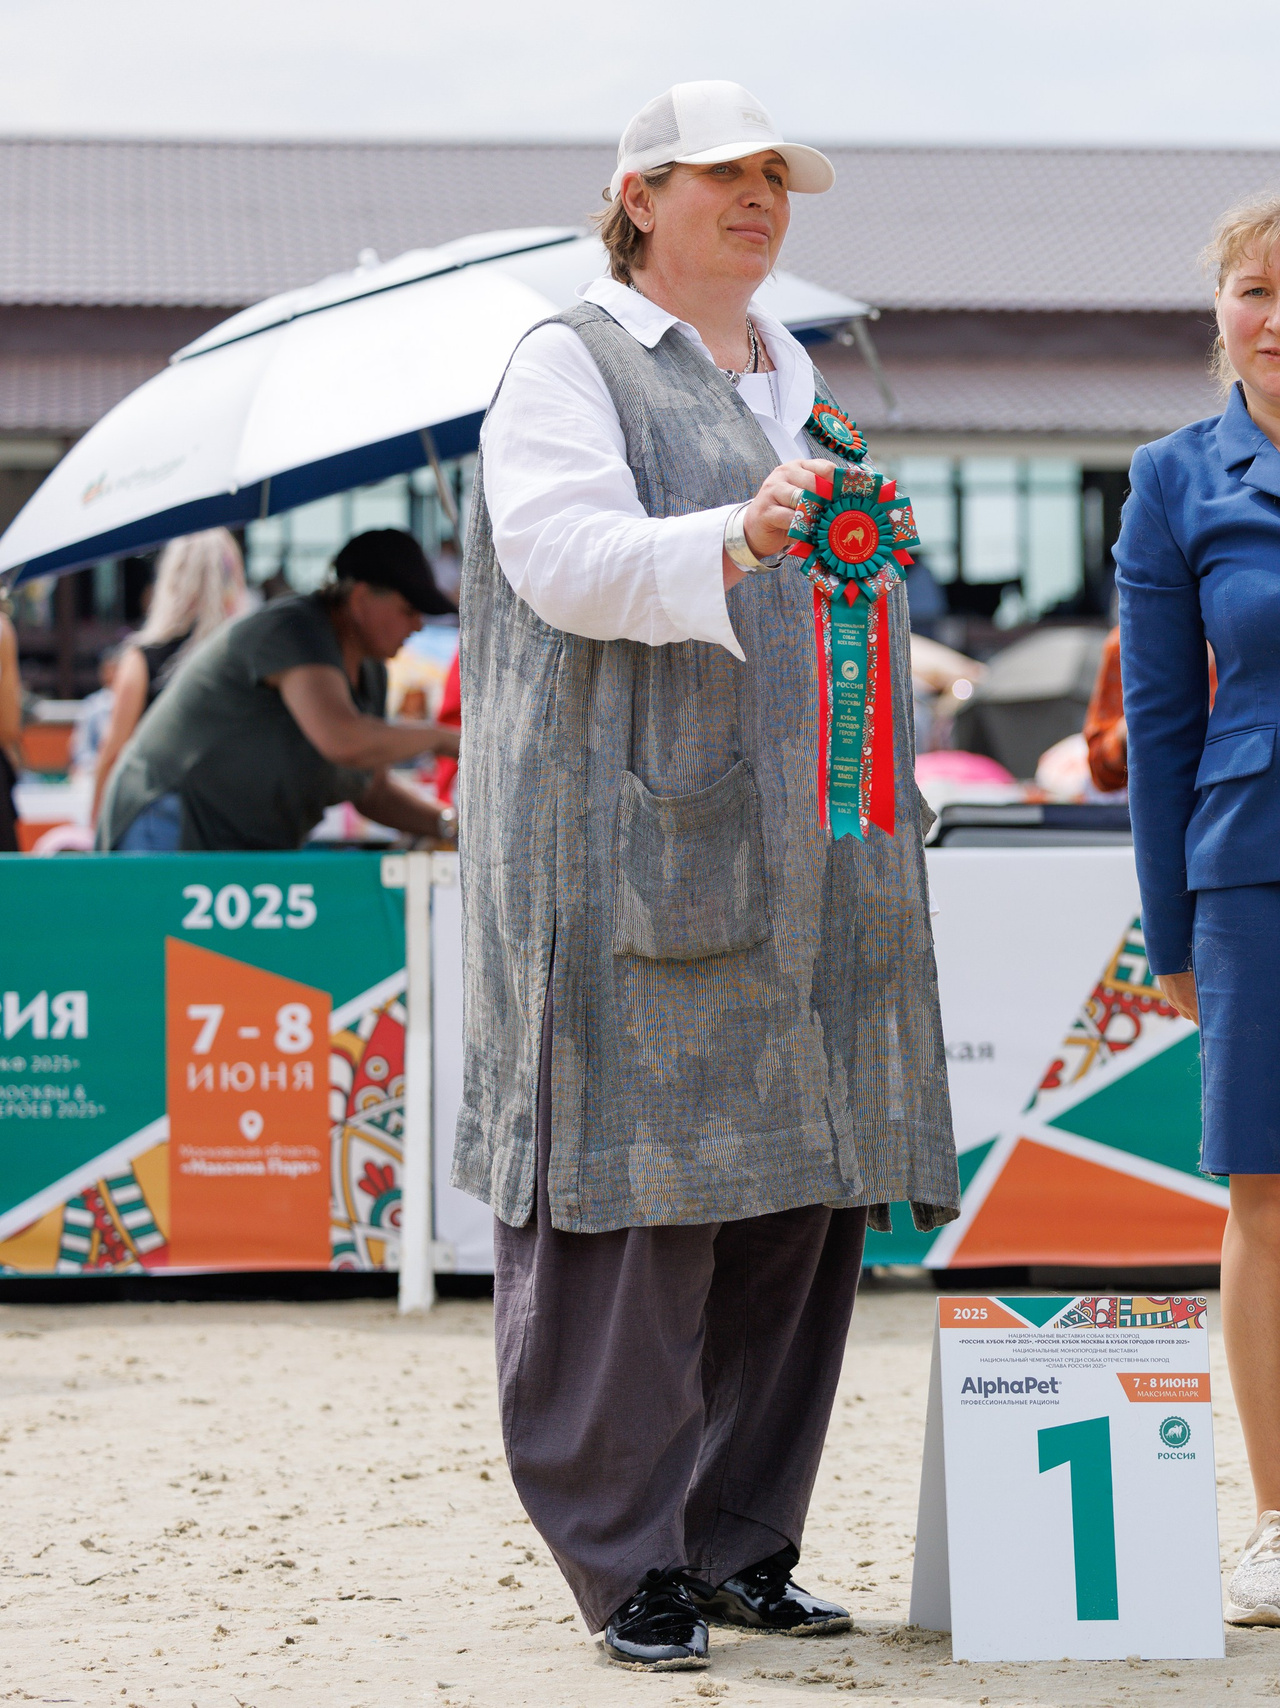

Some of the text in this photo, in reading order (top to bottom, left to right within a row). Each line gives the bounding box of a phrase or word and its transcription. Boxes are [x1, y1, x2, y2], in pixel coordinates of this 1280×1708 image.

[836, 681, 864, 690] РОССИЯ
[833, 764, 858, 772] ПОБЕДИТЕЛЬ
[182, 883, 318, 930] 2025
[186, 1003, 225, 1055] 7
[273, 1002, 314, 1055] 8
[186, 1060, 315, 1093] ИЮНЯ
[953, 1308, 988, 1320] 2025
[1133, 1378, 1140, 1388] 7
[1150, 1378, 1157, 1388] 8
[1160, 1378, 1198, 1388] ИЮНЯ
[1137, 1390, 1199, 1398] МАКСИМА ПАРК
[1157, 1452, 1196, 1460] РОССИЯ
[1037, 1416, 1119, 1621] 1
